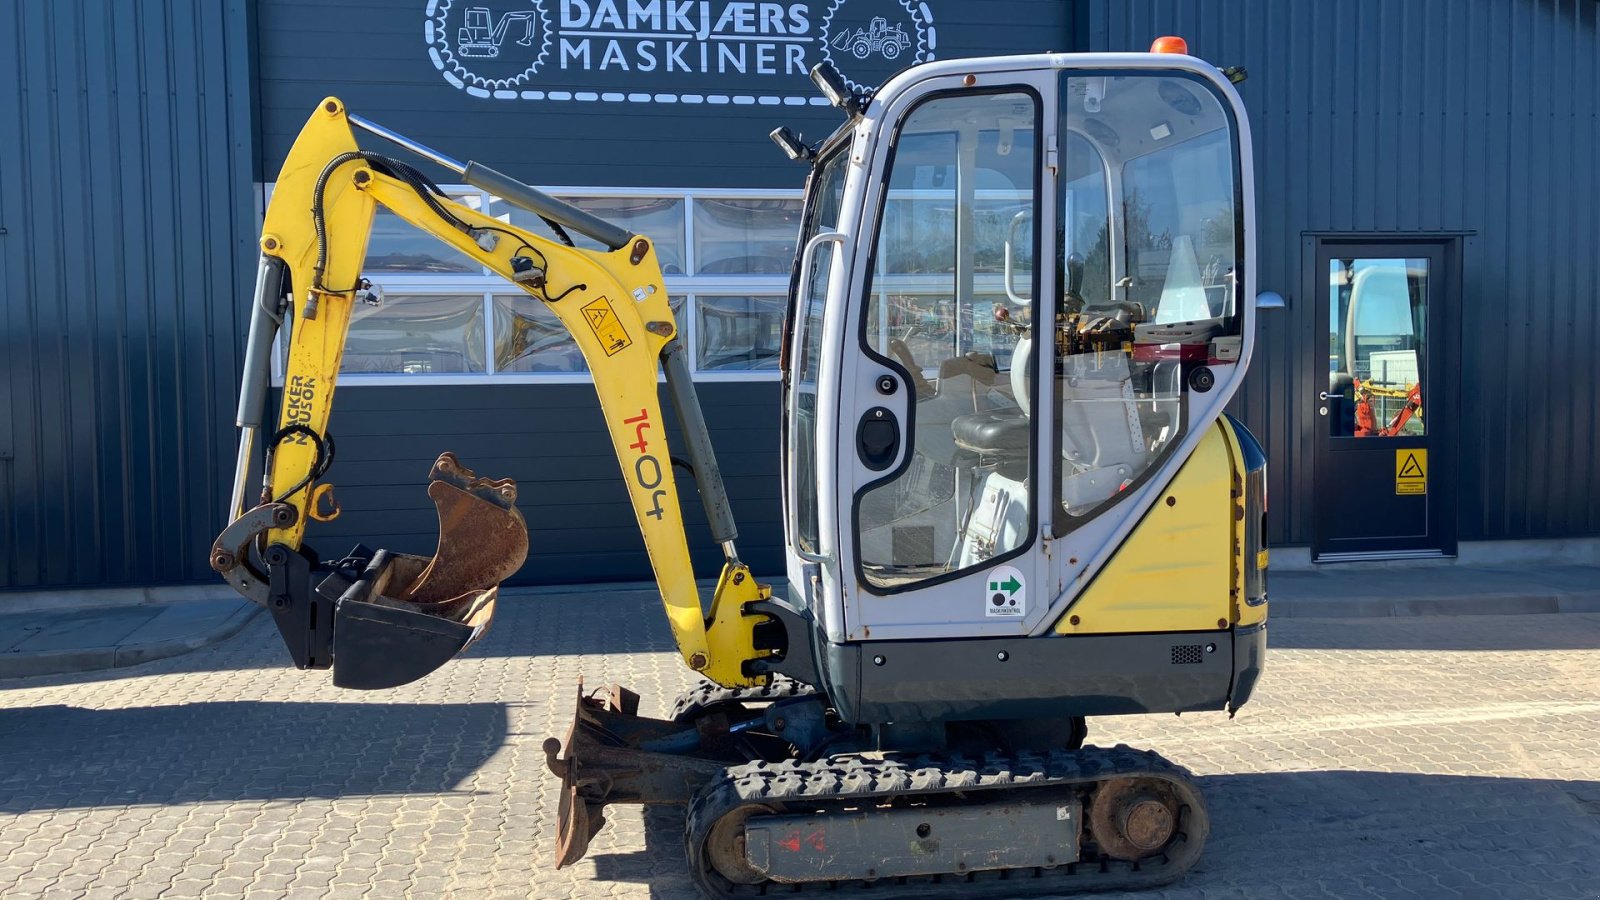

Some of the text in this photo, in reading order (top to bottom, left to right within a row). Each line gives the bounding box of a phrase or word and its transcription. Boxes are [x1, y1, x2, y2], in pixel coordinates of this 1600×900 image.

[559, 0, 811, 41] DAMKJÆRS
[559, 38, 809, 75] MASKINER
[623, 408, 667, 521] 1404
